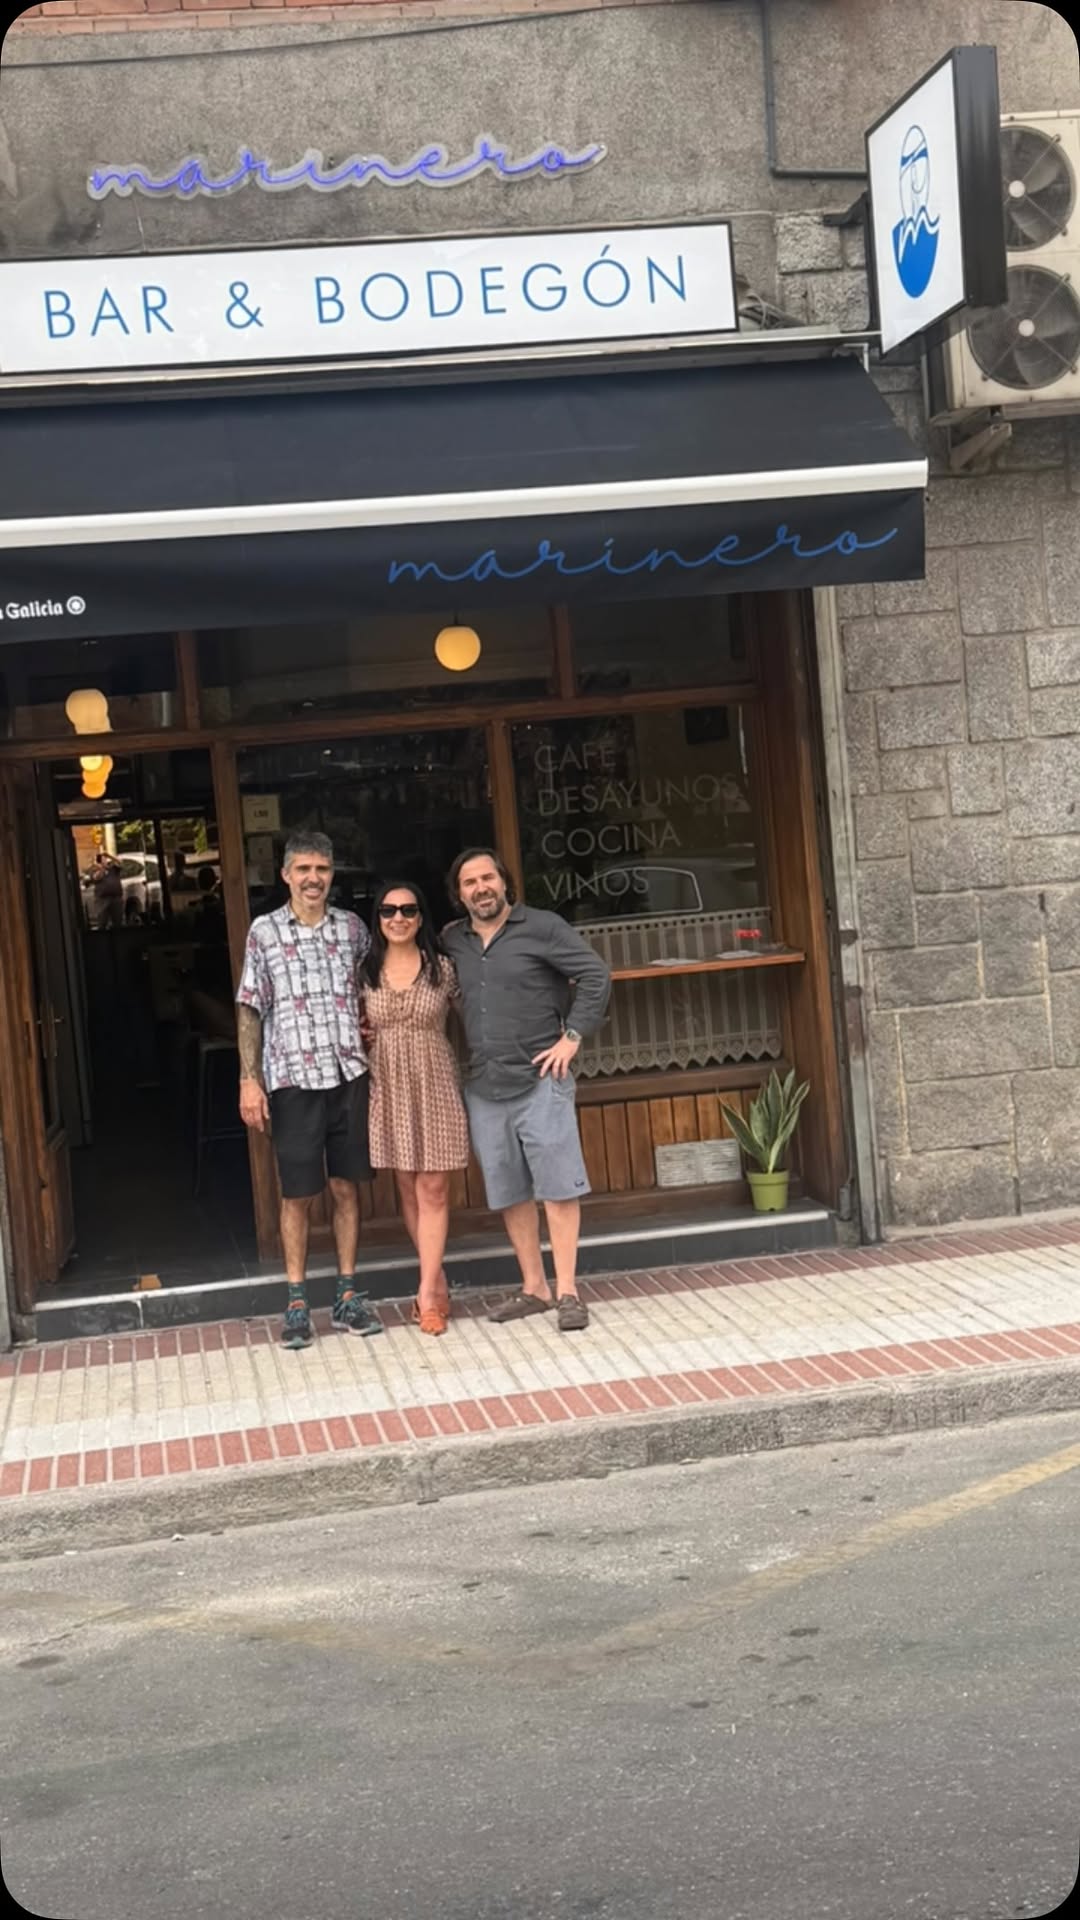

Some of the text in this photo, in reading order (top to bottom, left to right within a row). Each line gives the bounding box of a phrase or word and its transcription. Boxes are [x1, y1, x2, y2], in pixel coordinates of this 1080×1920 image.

[90, 137, 604, 195] marinero
[44, 245, 687, 339] BAR & BODEGÓN
[388, 524, 898, 583] marinero
[6, 599, 63, 619] Galicia
[538, 773, 738, 816] DESAYUNOS
[541, 820, 681, 859] COCINA
[543, 868, 649, 900] VINOS
